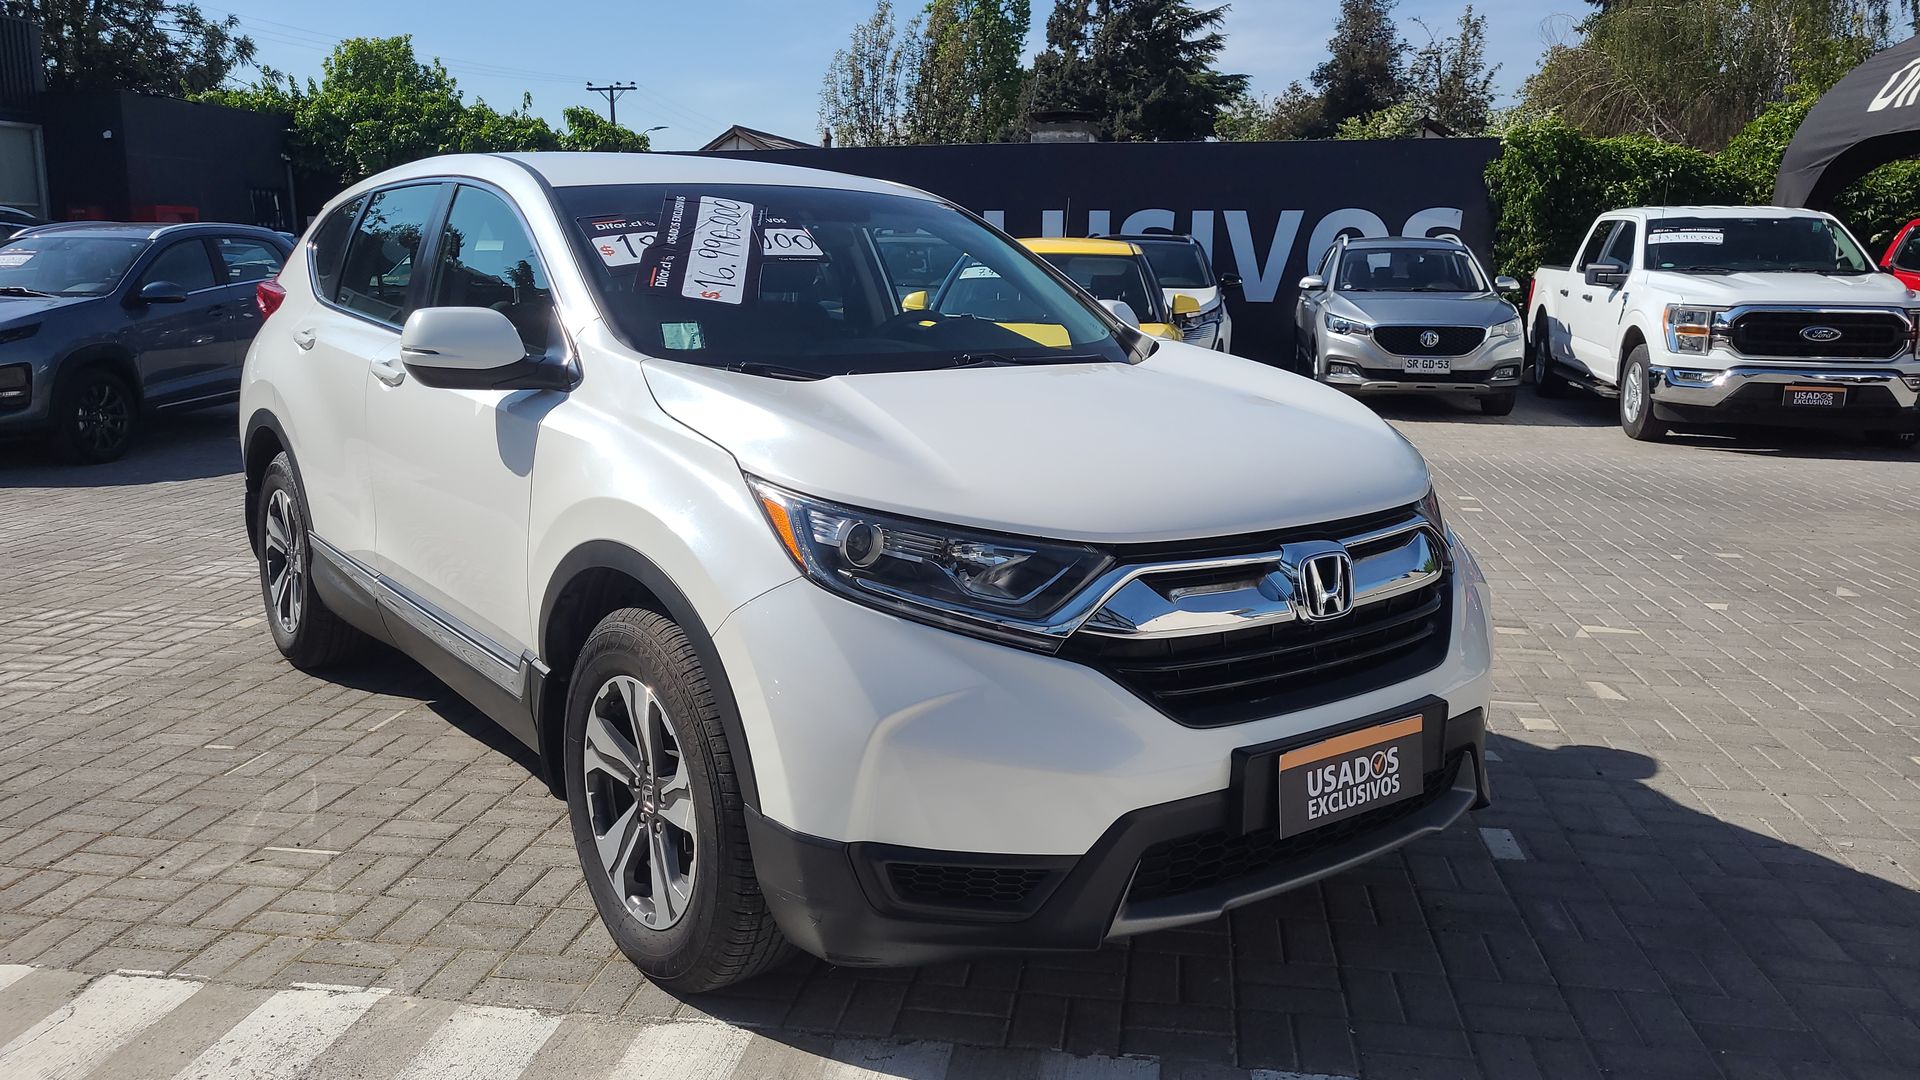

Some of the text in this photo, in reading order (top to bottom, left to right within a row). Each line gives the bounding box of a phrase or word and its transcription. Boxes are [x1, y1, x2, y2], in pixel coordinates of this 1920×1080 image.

[600, 244, 616, 257] $
[699, 289, 722, 300] $
[1794, 391, 1834, 400] USADOS
[1793, 398, 1833, 406] EXCLUSIVOS
[1307, 746, 1400, 798] USADOS
[1307, 773, 1401, 821] EXCLUSIVOS
